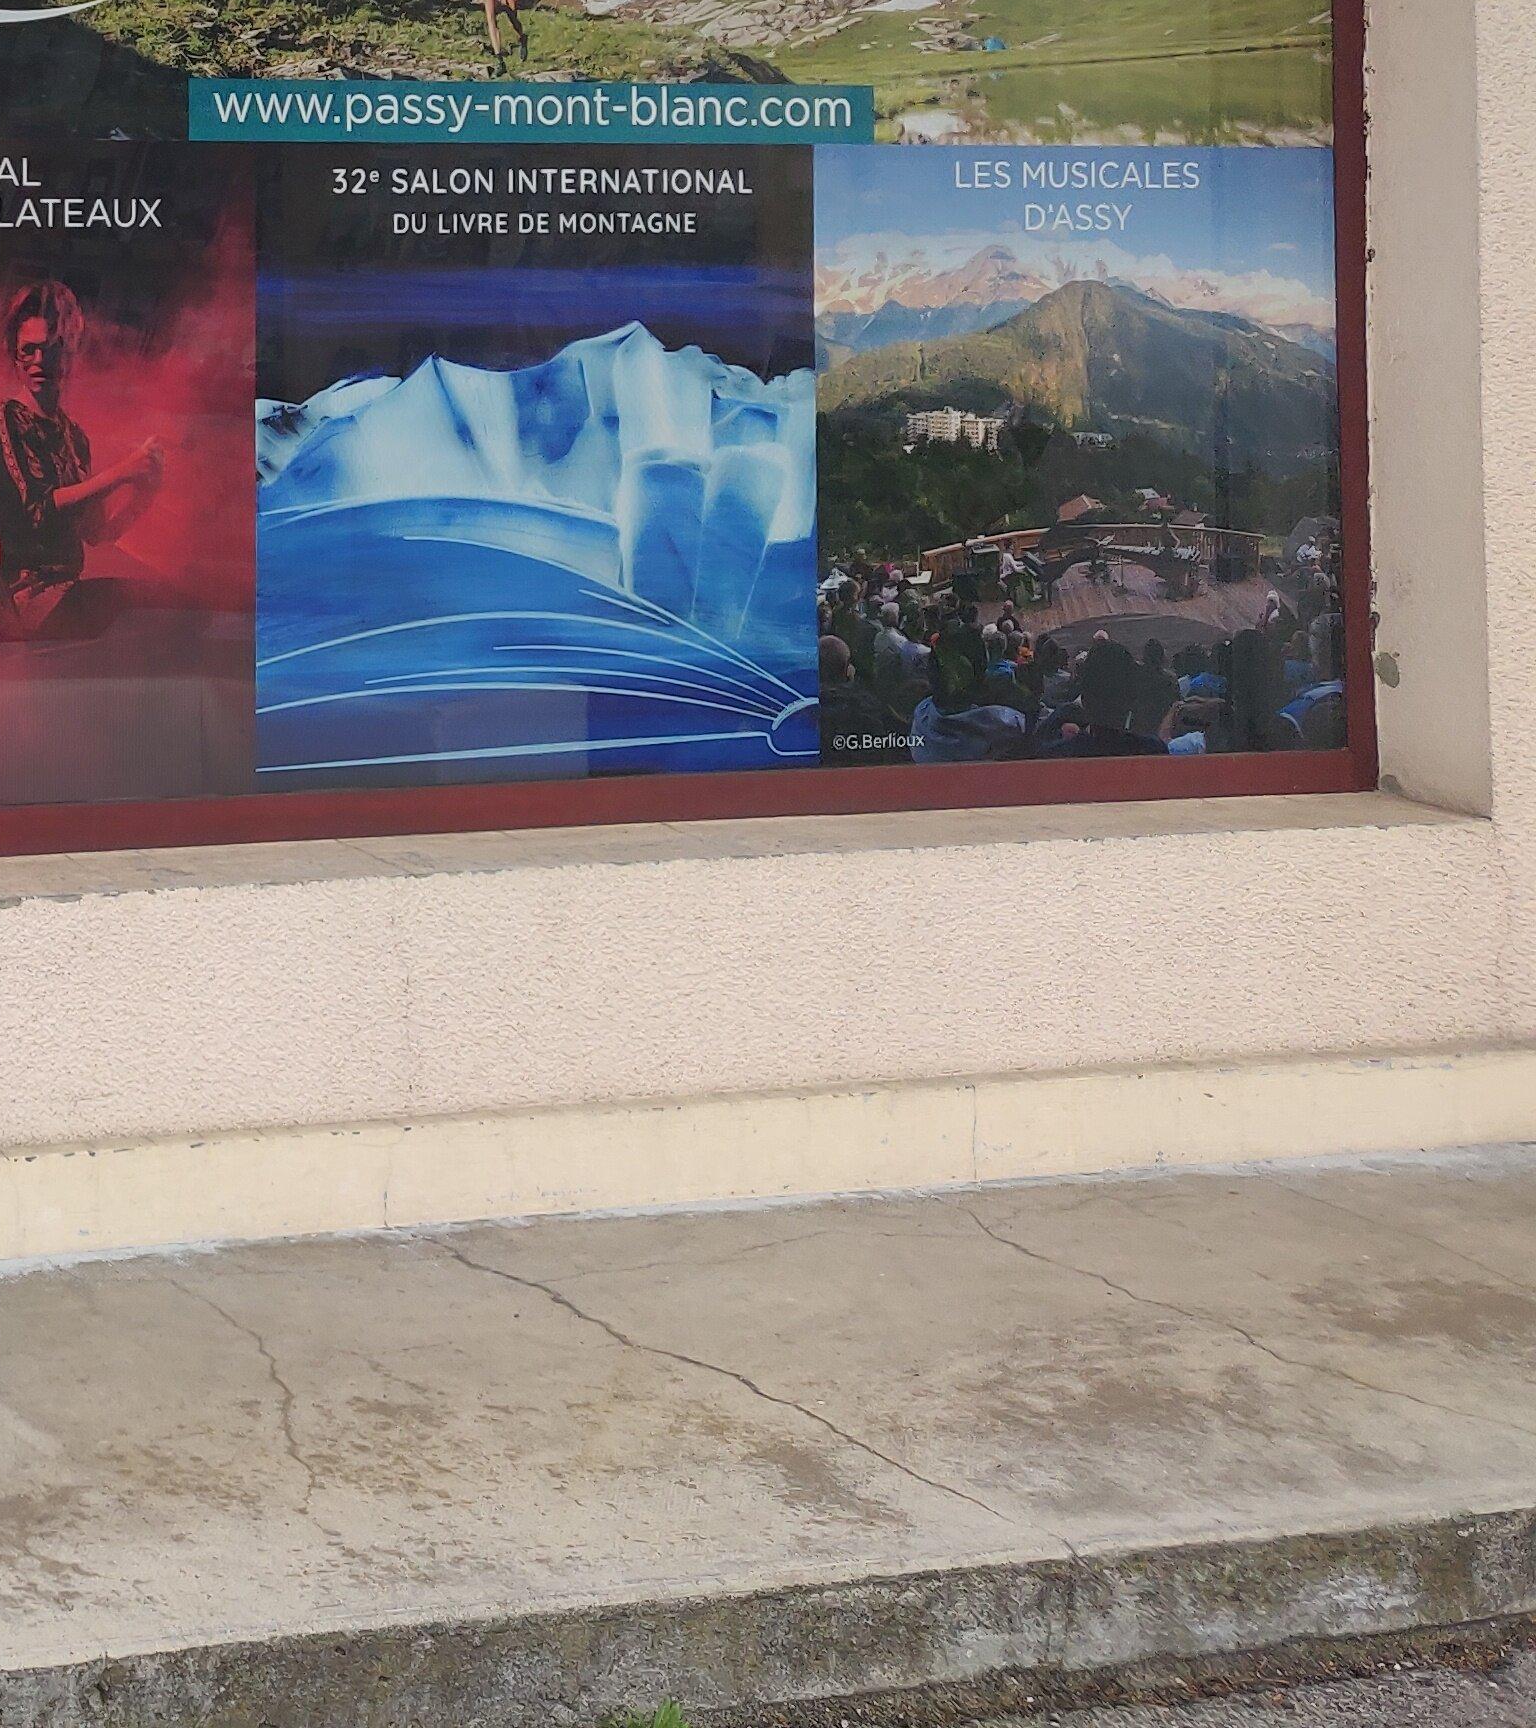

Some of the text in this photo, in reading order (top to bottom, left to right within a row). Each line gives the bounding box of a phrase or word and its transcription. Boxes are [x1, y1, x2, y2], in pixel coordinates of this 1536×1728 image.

[213, 85, 854, 133] www.passy-mont-blanc.com
[391, 168, 493, 195] SALON
[506, 169, 753, 195] INTERNATIONAL
[954, 161, 1200, 190] LES MUSICALES
[393, 213, 697, 235] DU LIVRE DE MONTAGNE
[1024, 204, 1132, 232] D'ASSY
